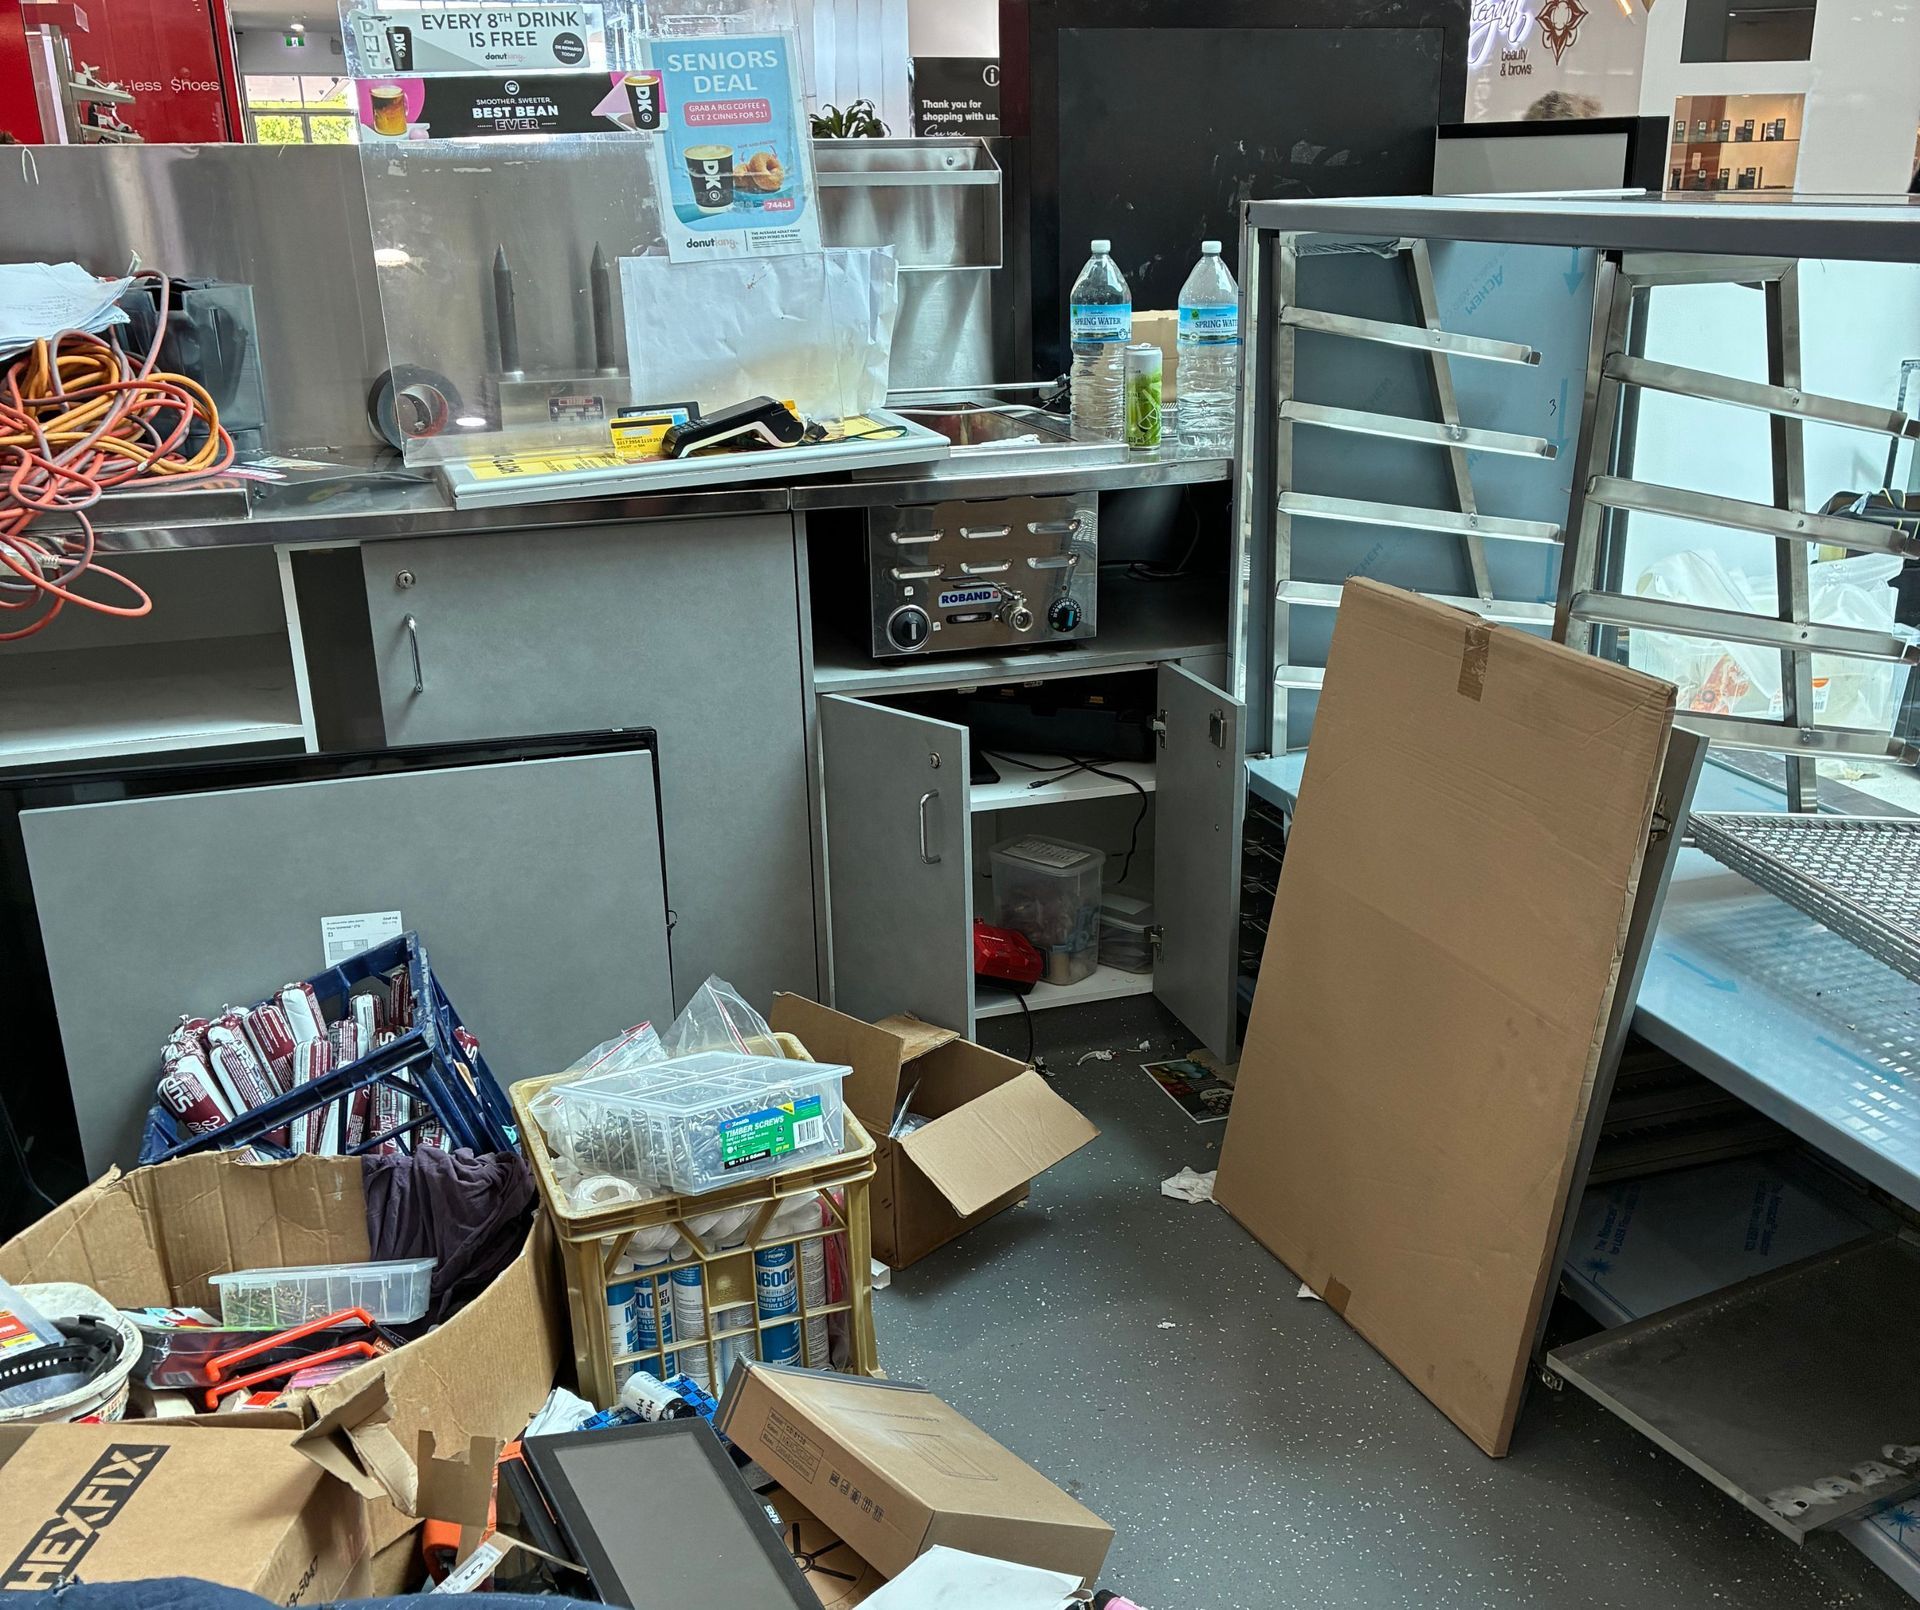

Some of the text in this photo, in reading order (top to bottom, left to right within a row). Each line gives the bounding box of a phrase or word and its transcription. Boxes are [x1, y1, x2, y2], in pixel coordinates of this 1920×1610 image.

[421, 11, 579, 30] EVERY 8TH DRINK
[469, 31, 538, 48] IS FREE
[667, 50, 779, 72] SENIORS
[1501, 48, 1529, 62] beauty
[1500, 63, 1533, 76] & brows
[170, 76, 220, 93] $hoes
[693, 73, 758, 94] DEAL
[635, 86, 654, 113] DK
[922, 99, 982, 110] Thank you for
[472, 105, 559, 119] BEST BEAN
[689, 104, 711, 113] GRAB
[717, 103, 733, 112] REG
[733, 102, 761, 110] COFFEE
[690, 113, 705, 122] GET
[739, 112, 754, 120] FOR
[922, 111, 999, 122] shopping with us.
[495, 118, 540, 131] EVER
[702, 160, 722, 190] DK
[1465, 265, 1504, 315] ACHEM
[1074, 317, 1122, 326] SPRING WATER
[1194, 319, 1222, 329] SPRING
[1549, 398, 1557, 417] 3
[941, 591, 992, 604] ROBAND
[725, 1123, 755, 1139] TIMBER
[754, 1115, 785, 1130] SCREWS
[3, 1449, 157, 1592] HEXFIX
